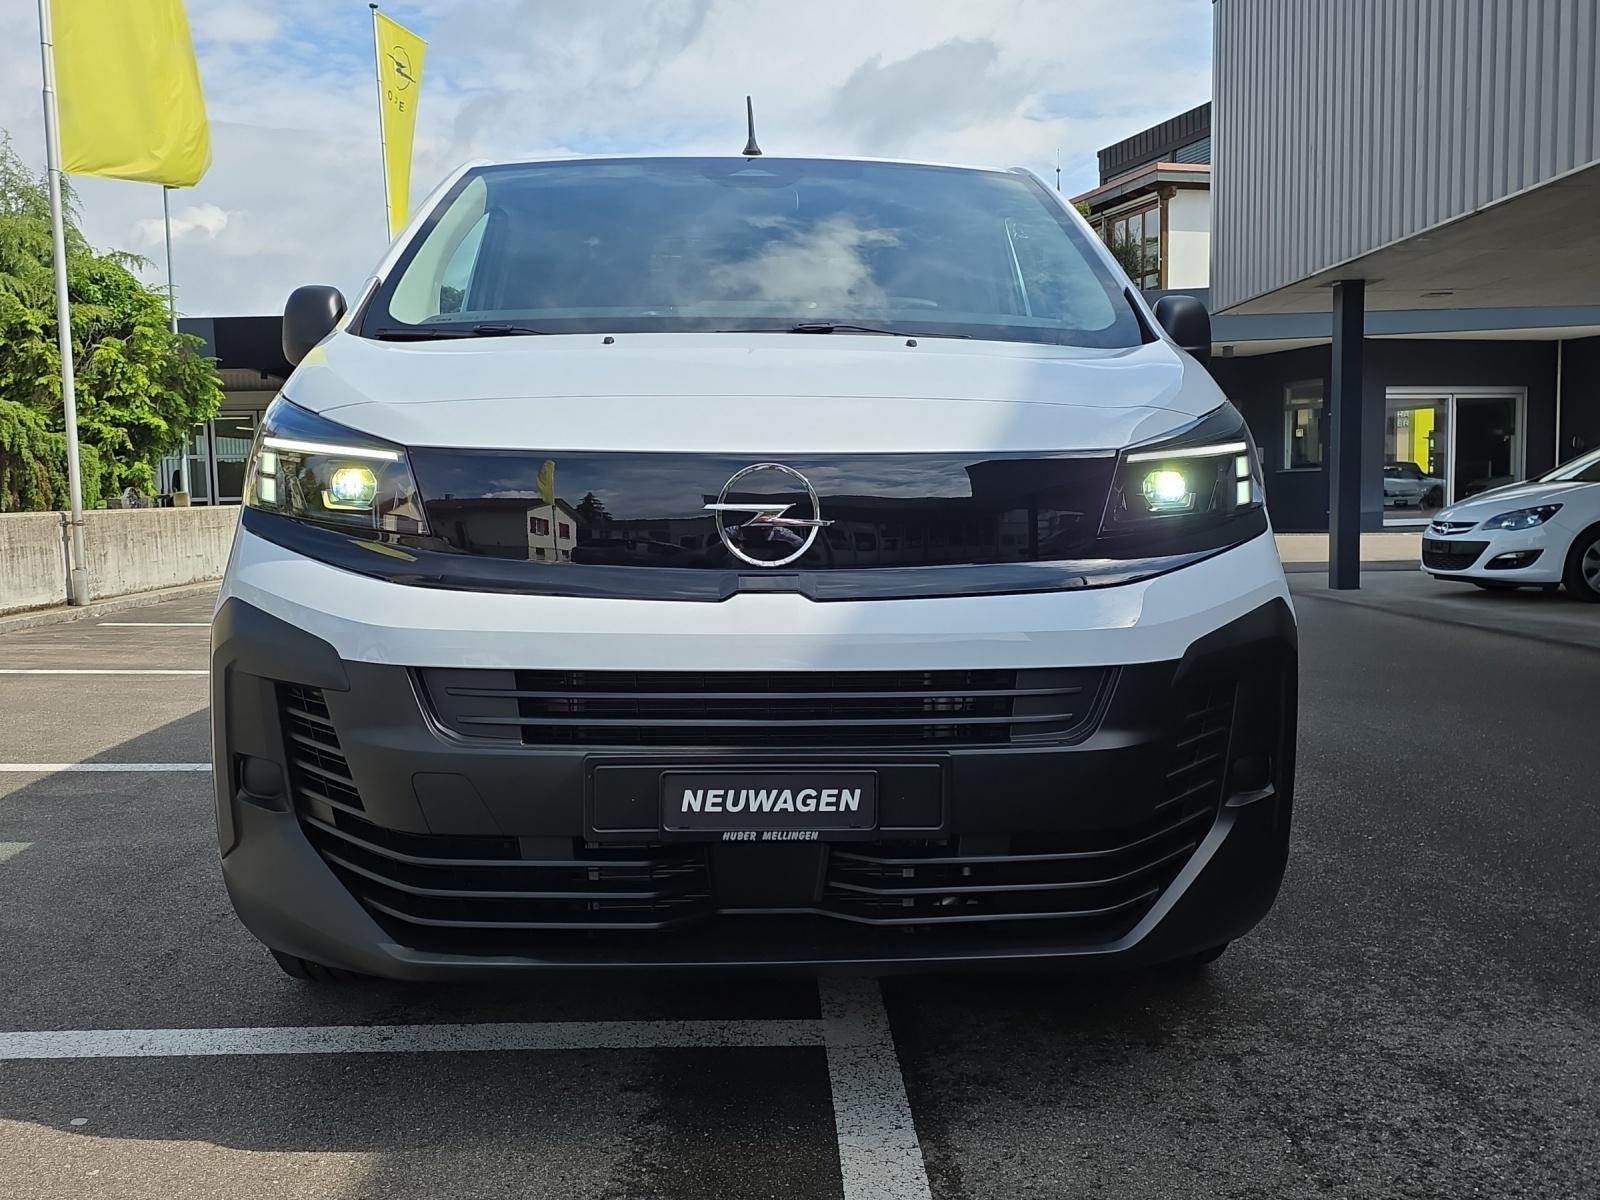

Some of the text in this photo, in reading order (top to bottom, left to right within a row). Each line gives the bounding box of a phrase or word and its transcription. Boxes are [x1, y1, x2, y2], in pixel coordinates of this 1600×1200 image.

[681, 789, 861, 812] NEUWAGEN
[722, 831, 819, 840] HUBER MELLINGEN
